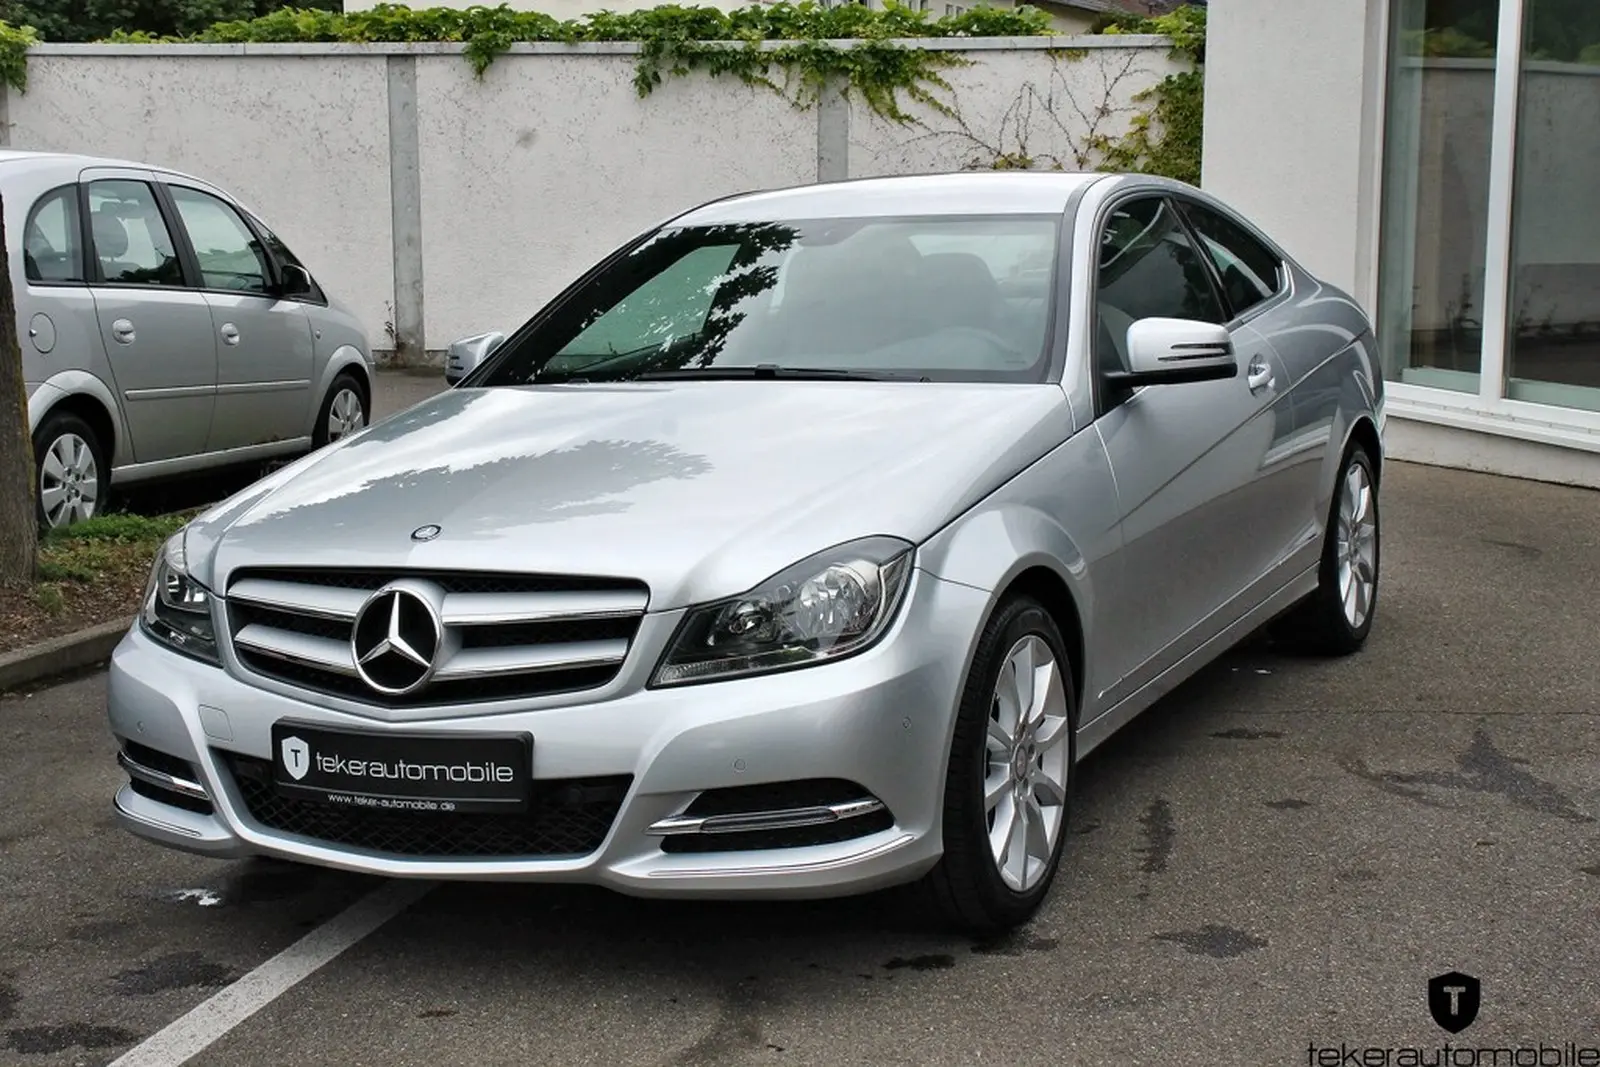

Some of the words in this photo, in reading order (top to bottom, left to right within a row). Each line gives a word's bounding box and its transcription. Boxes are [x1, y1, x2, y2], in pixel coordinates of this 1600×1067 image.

[290, 749, 302, 768] T
[315, 751, 514, 783] tekerautomobile
[327, 792, 456, 812] www.teker-automobile.de
